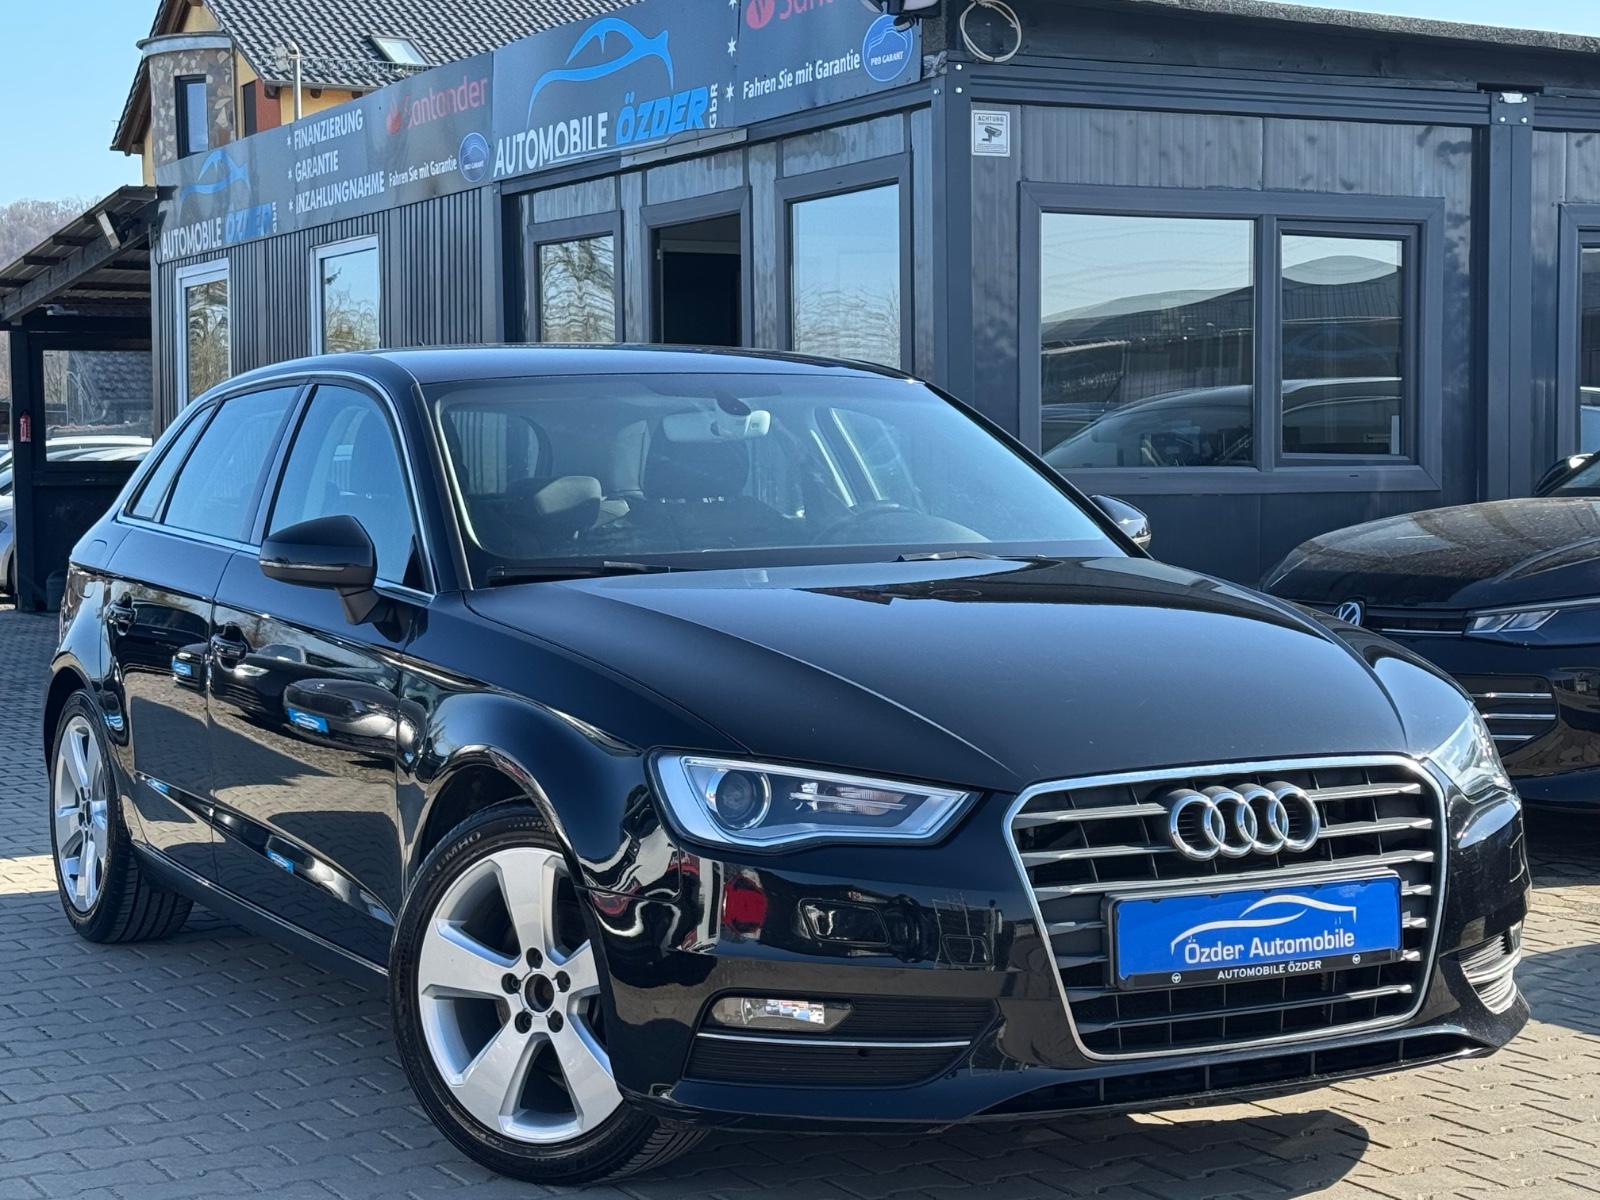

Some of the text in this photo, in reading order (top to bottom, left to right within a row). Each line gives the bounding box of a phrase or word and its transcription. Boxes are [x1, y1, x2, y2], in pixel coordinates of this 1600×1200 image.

[743, 49, 860, 99] Fahren Sie mit Garantie
[870, 51, 904, 66] PRO GARANT
[403, 75, 488, 129] Santander
[709, 82, 718, 128] GbR
[294, 108, 363, 151] FINANZIERUNG
[493, 86, 709, 178] AUTOMOBILE ÖZDER
[295, 150, 339, 182] GARANTIE
[389, 170, 408, 187] Fahren
[408, 165, 418, 182] Sie
[419, 161, 430, 179] mit
[430, 155, 457, 176] Garantie
[296, 171, 385, 214] INZAHLUNGNAHME
[162, 217, 222, 261] AUTOMOBILE
[1185, 928, 1354, 964] Özder Automobile
[1217, 960, 1322, 980] AUTOMOBILE ÖZDER
